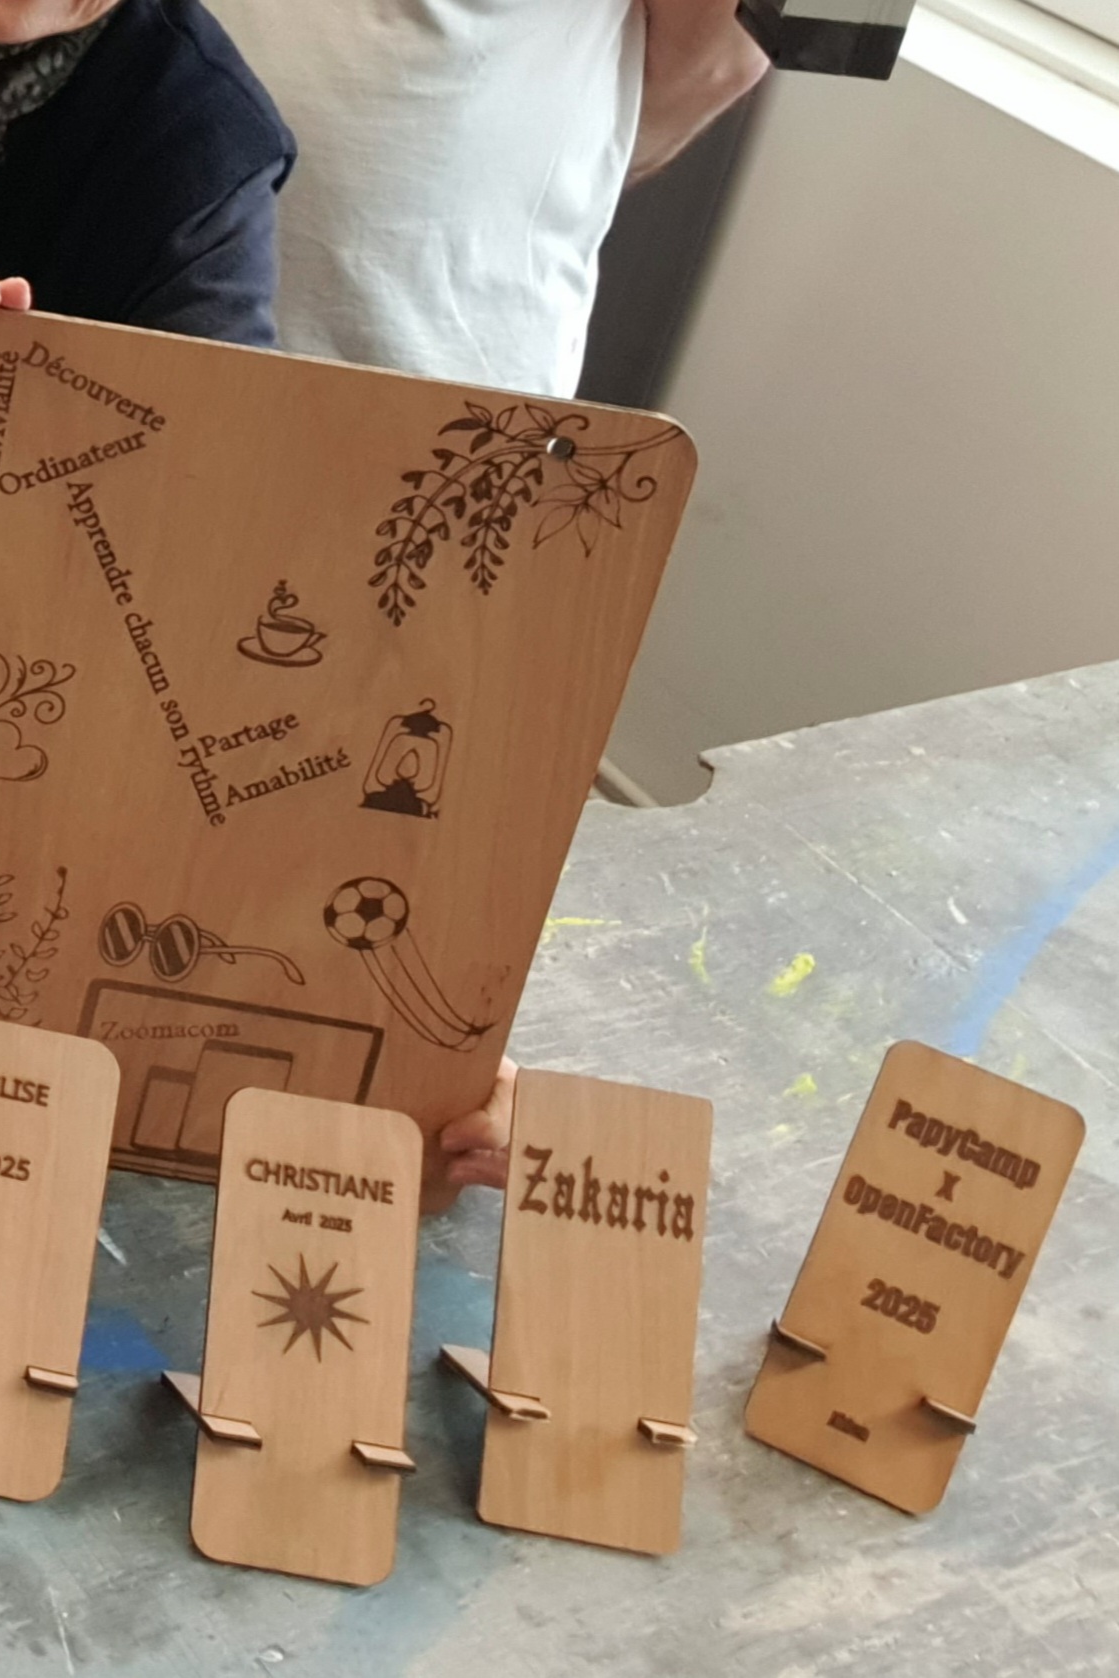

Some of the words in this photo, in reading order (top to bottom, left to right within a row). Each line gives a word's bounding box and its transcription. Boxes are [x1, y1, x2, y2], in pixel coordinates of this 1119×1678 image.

[21, 341, 166, 432] Découverte
[67, 482, 133, 606] Apprendre
[124, 612, 170, 694] chacun
[160, 699, 190, 742] son
[178, 746, 226, 827] rythme
[198, 713, 299, 758] Partage
[225, 747, 351, 808] Amabilité
[100, 1020, 240, 1041] Zoomacom
[888, 1099, 1041, 1190] PapyCamp
[245, 1158, 394, 1205] CHRISTIANE
[519, 1145, 694, 1242] Zakaria
[282, 1208, 313, 1225] Avril
[319, 1213, 353, 1233] 2025
[843, 1174, 1025, 1279] OpenFactory
[861, 1278, 941, 1335] 2025
